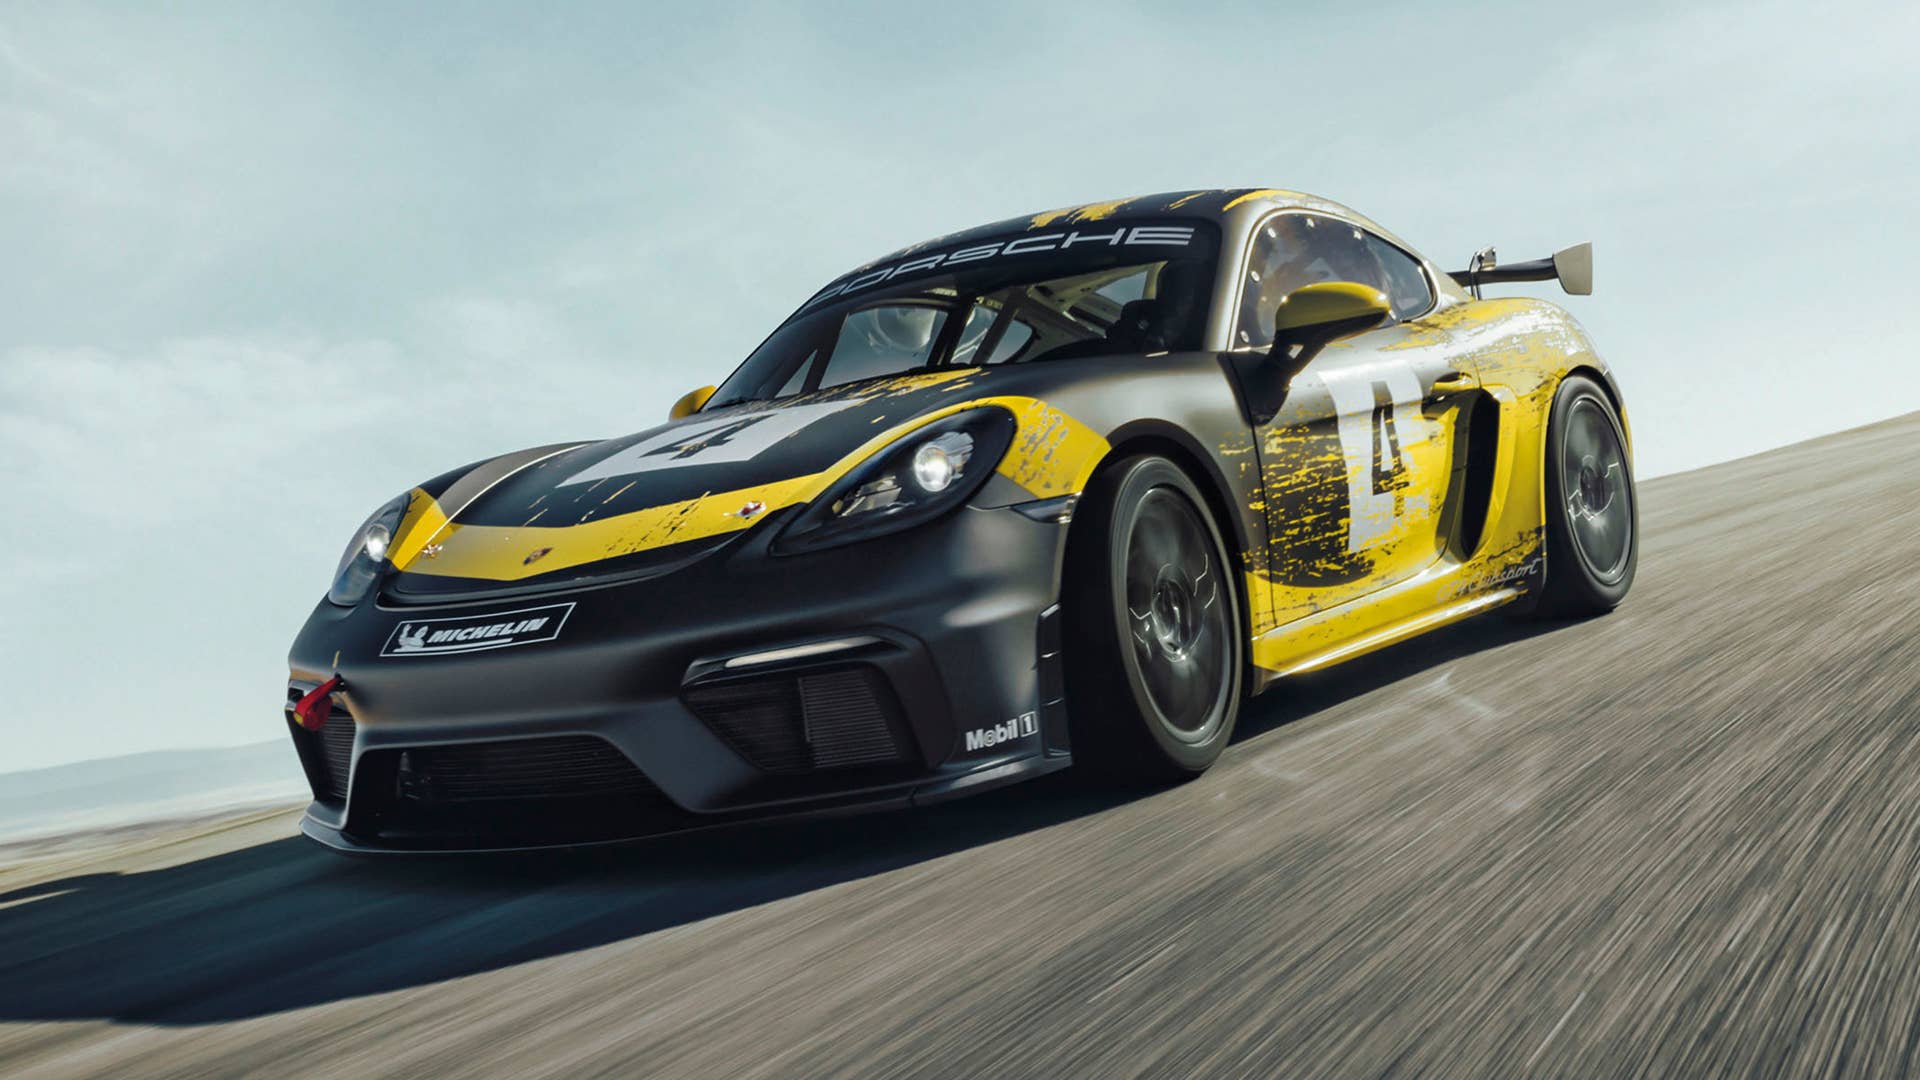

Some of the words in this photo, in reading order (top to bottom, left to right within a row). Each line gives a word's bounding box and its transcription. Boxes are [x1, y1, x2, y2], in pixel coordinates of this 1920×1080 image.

[801, 226, 1194, 306] PORSCHE
[1371, 381, 1410, 518] 4
[427, 616, 549, 643] MICHELIN
[966, 719, 1019, 751] Mobil
